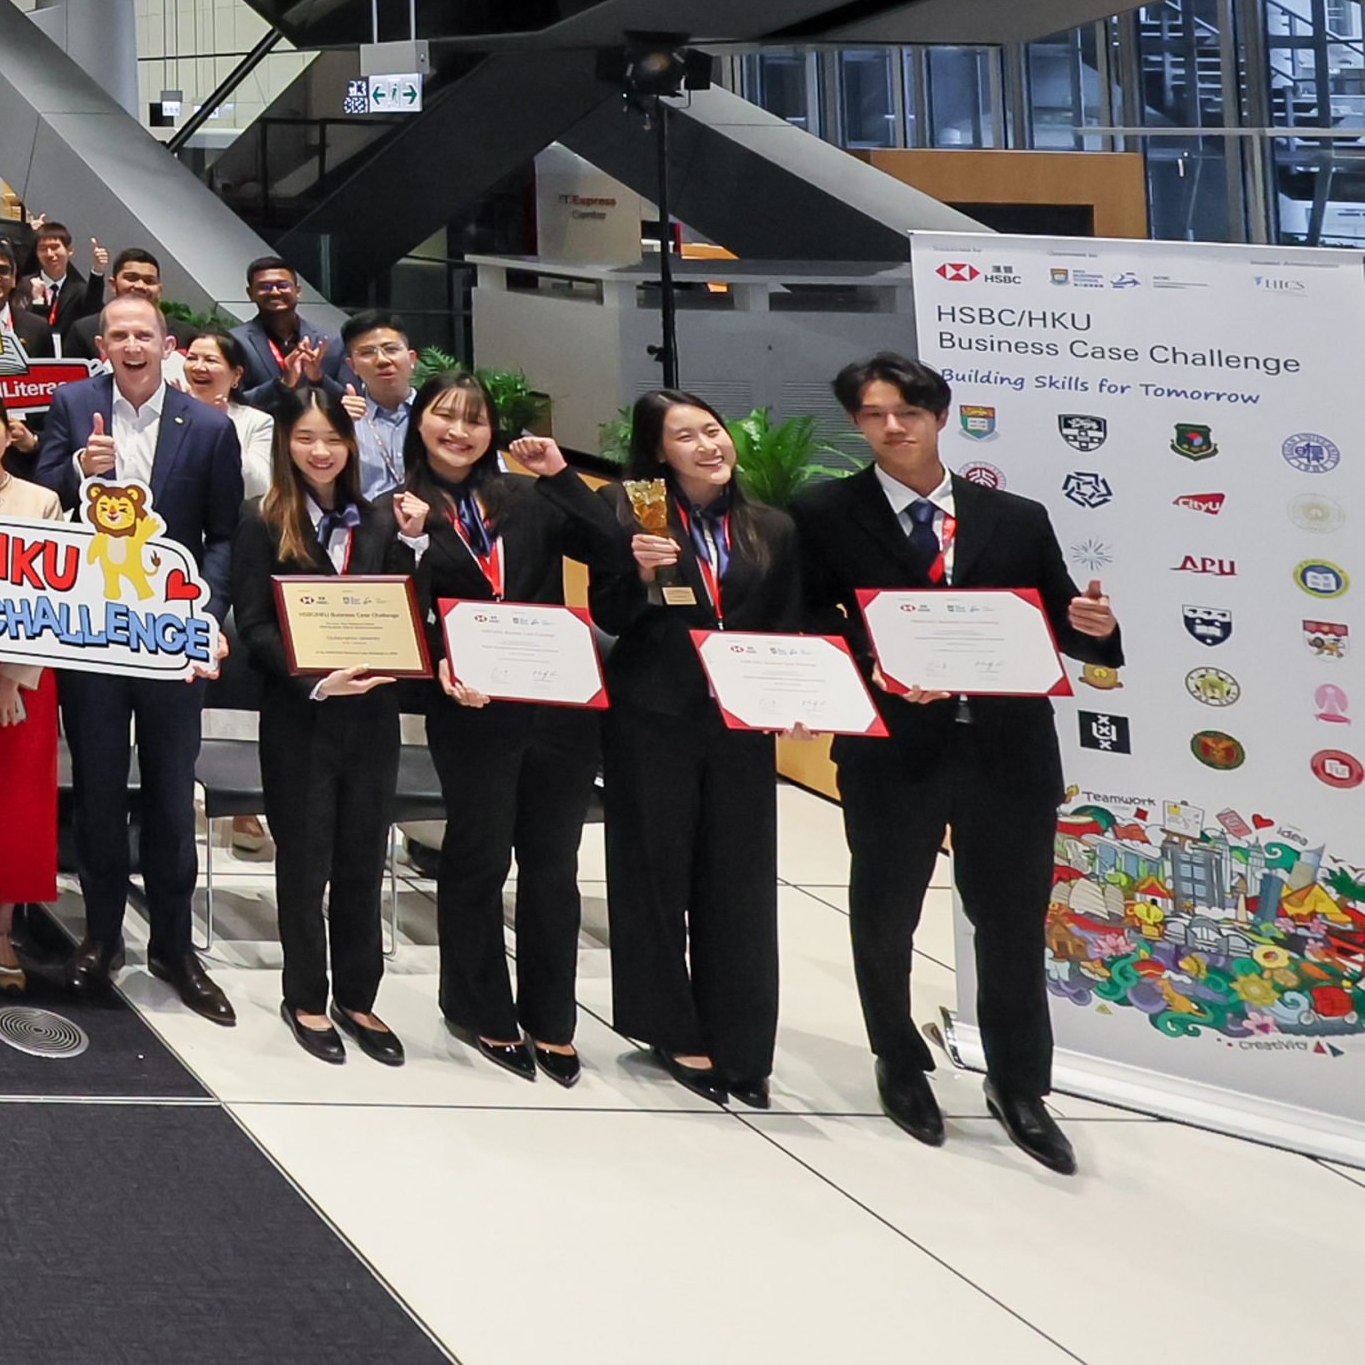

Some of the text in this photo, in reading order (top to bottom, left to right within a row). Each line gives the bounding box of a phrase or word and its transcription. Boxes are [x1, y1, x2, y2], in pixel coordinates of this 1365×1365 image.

[572, 195, 617, 206] Express
[984, 274, 1022, 285] HSBC
[937, 304, 1091, 332] HSBC/HKU
[939, 331, 1300, 376] Business Case Challenge
[941, 368, 1260, 404] Building Skills for Tomorrow
[1180, 554, 1236, 576] APU
[1082, 790, 1157, 807] Teamwork
